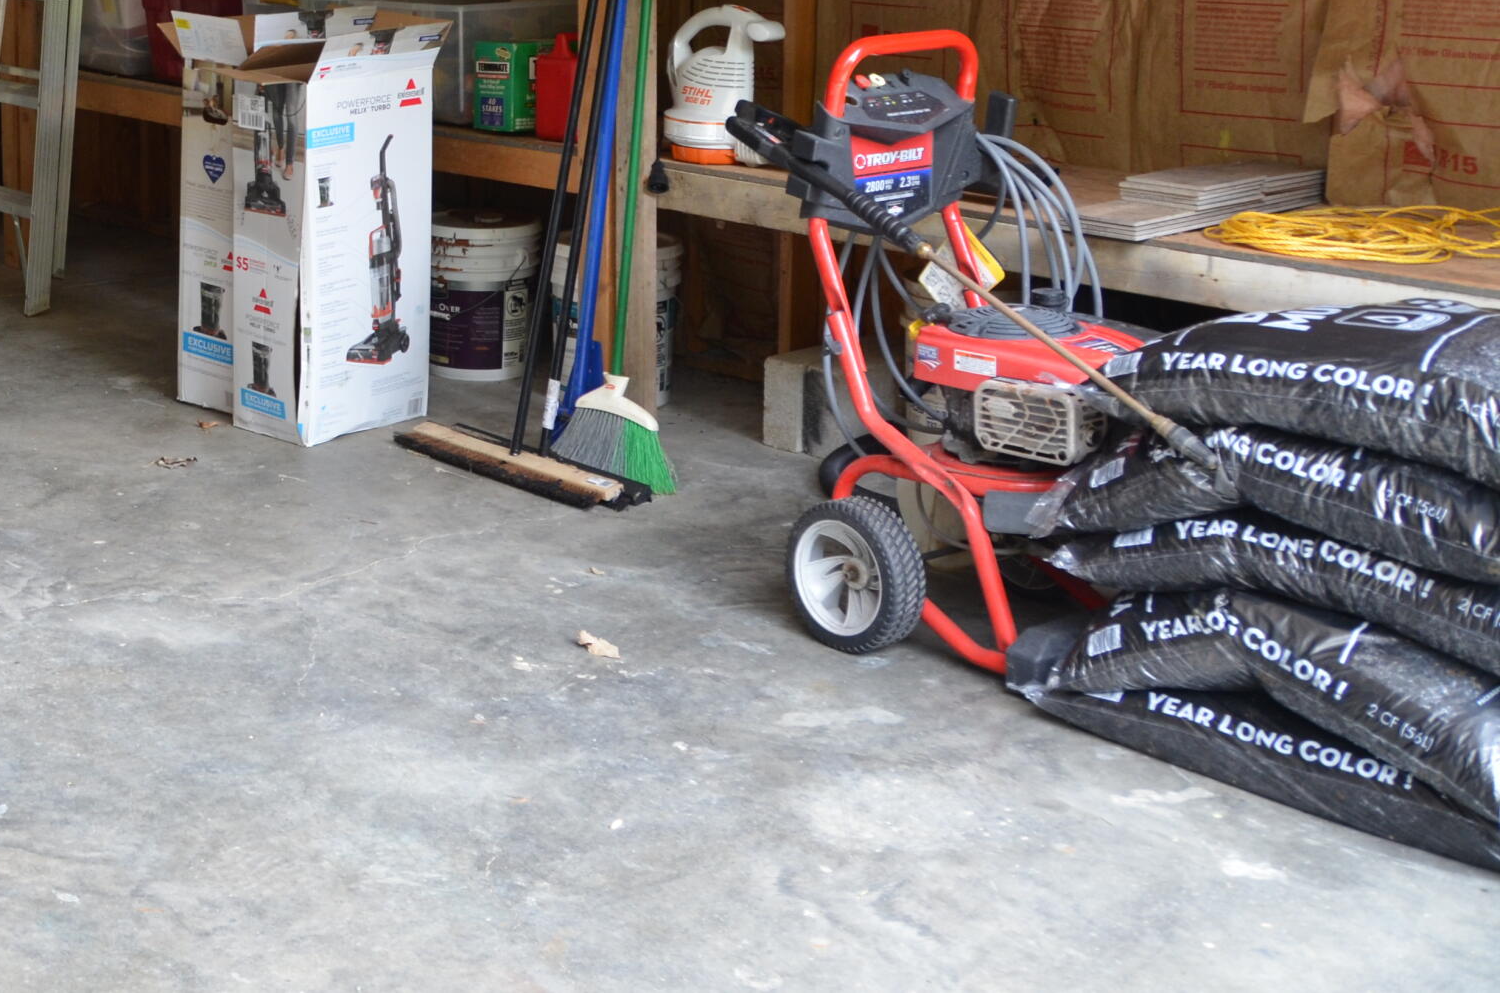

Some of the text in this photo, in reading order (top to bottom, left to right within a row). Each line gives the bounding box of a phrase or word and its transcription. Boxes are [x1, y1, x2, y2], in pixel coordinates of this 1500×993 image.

[682, 85, 713, 99] STIHL
[336, 93, 392, 110] POWERFORCE
[371, 103, 391, 113] TURBO
[482, 105, 503, 113] STAKES
[311, 125, 351, 138] EXCLUSIVE
[866, 147, 924, 167] TROY-BILT
[865, 179, 885, 193] 2800
[899, 175, 911, 188] 2.3
[236, 255, 250, 272] $5
[188, 336, 233, 356] EXCLUSIVE
[1163, 351, 1226, 372] YEAR
[1230, 353, 1308, 380] LONG
[1175, 519, 1238, 540] YEAR
[1241, 525, 1314, 559] LONG
[1471, 603, 1493, 620] CF
[1140, 614, 1204, 642] YEAR
[1147, 691, 1215, 728] YEAR
[1217, 714, 1294, 756] LONG
[1366, 703, 1379, 718] 2
[1380, 710, 1401, 729] CF
